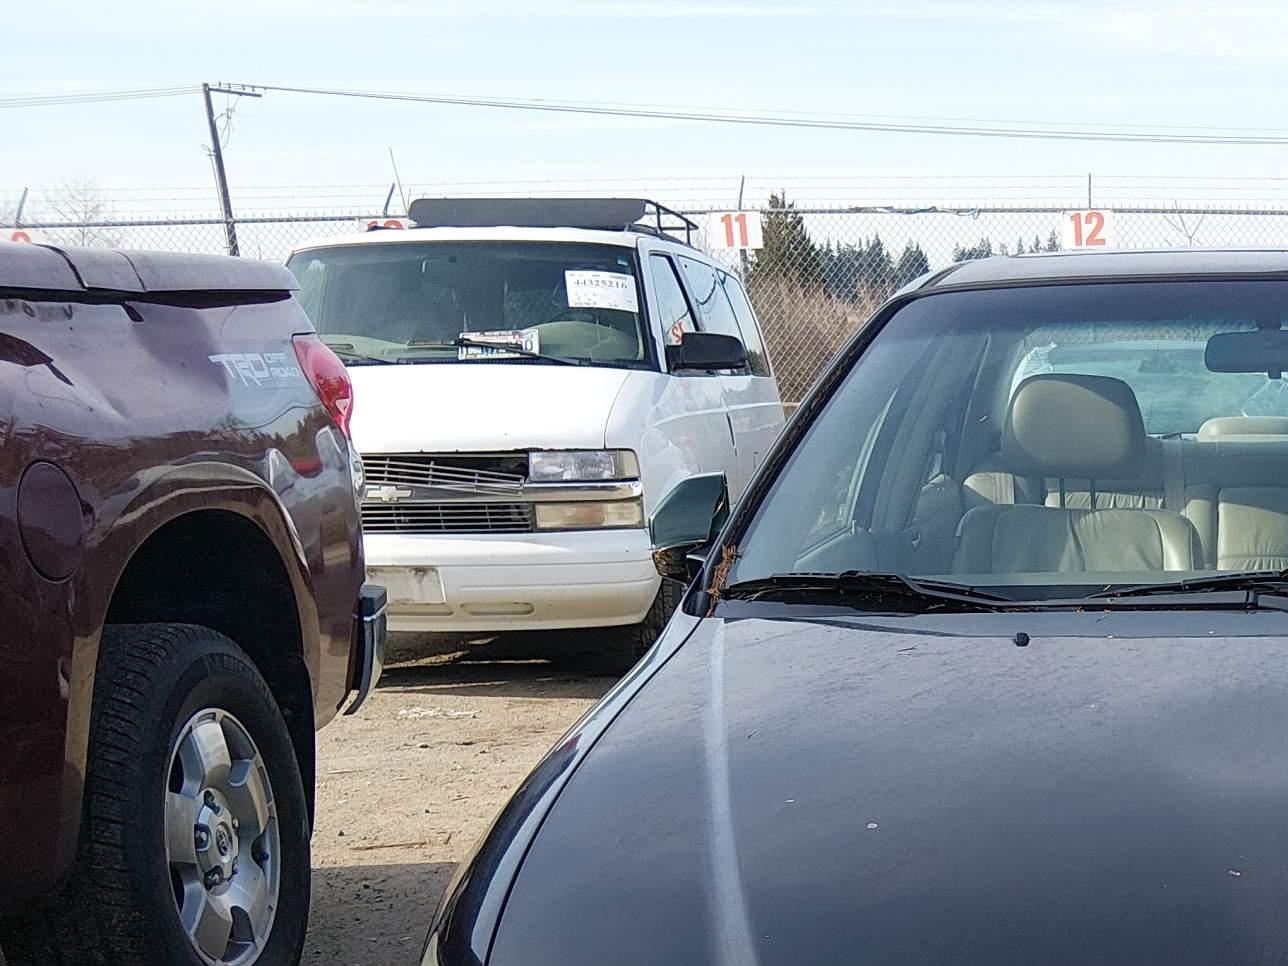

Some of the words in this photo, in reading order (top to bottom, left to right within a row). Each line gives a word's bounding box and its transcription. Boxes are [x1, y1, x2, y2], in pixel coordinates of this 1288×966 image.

[722, 214, 748, 247] 11
[1072, 212, 1104, 246] 12
[208, 352, 270, 386] TRD
